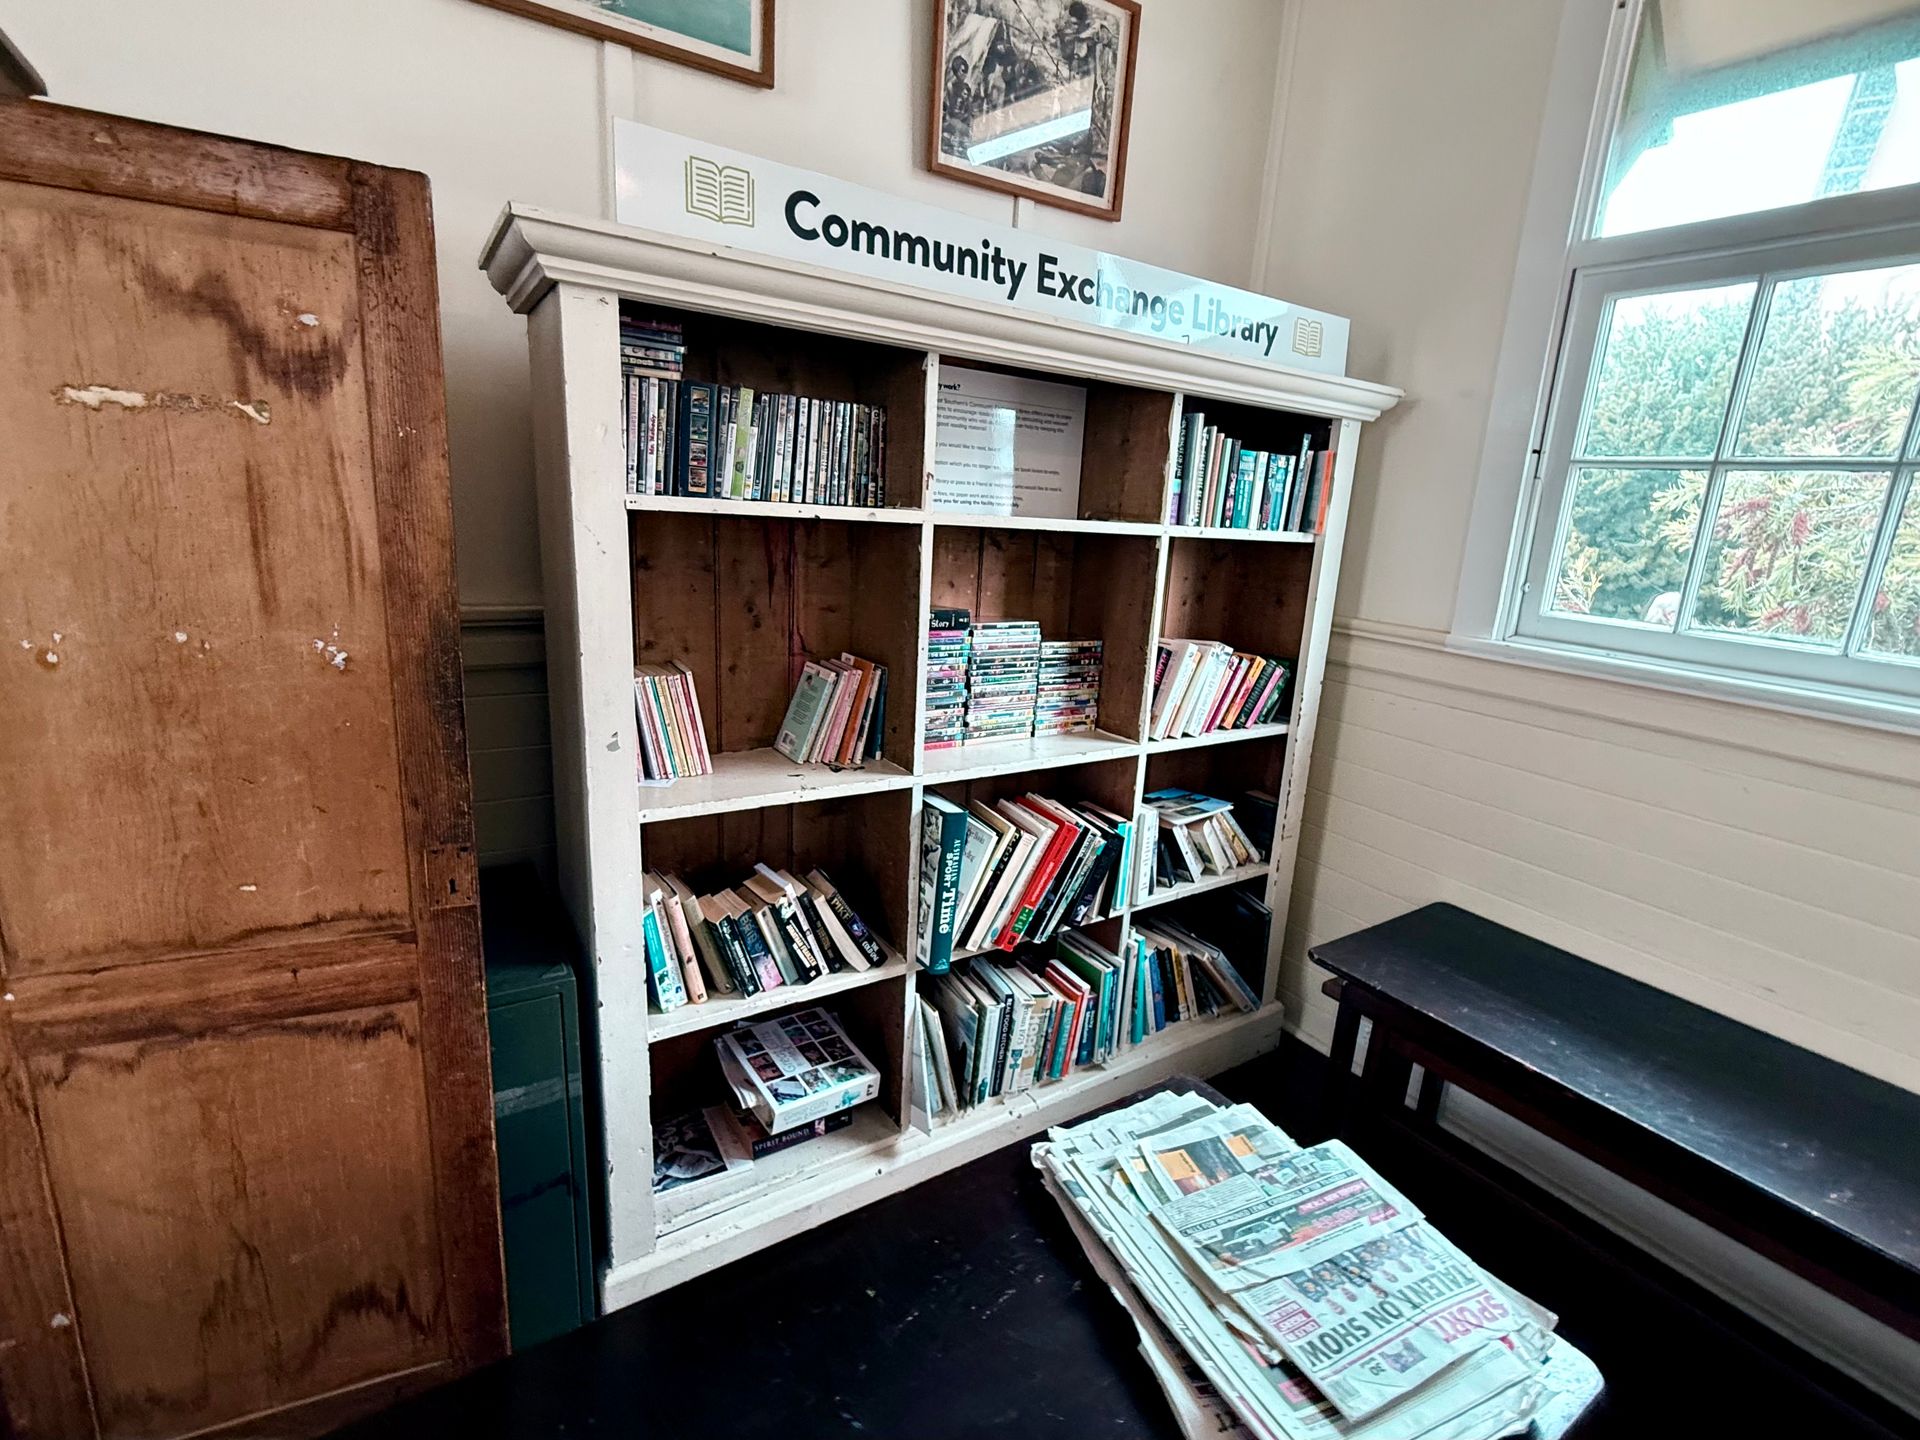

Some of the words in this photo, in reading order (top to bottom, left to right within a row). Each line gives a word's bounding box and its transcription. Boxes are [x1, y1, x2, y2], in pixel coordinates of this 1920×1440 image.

[785, 190, 1027, 301] Community
[1037, 253, 1185, 332] Exchange
[1192, 293, 1279, 356] Library
[943, 383, 961, 391] work?
[931, 619, 950, 628] Story
[943, 852, 954, 888] SPORT
[950, 839, 961, 882] AUSTRALIAN
[832, 898, 850, 921] PIKE
[939, 887, 957, 934] Time
[1005, 998, 1013, 1016] REAL
[1002, 1015, 1011, 1033] FOOD
[998, 1033, 1008, 1060] KITCHEN
[754, 1140, 779, 1151] SPIRIT
[782, 1128, 810, 1142] BOUND
[1397, 1264, 1475, 1313] TALENT
[1362, 1301, 1403, 1330] ON
[1429, 1295, 1511, 1344] SPORT
[1298, 1317, 1372, 1368] SHOW
